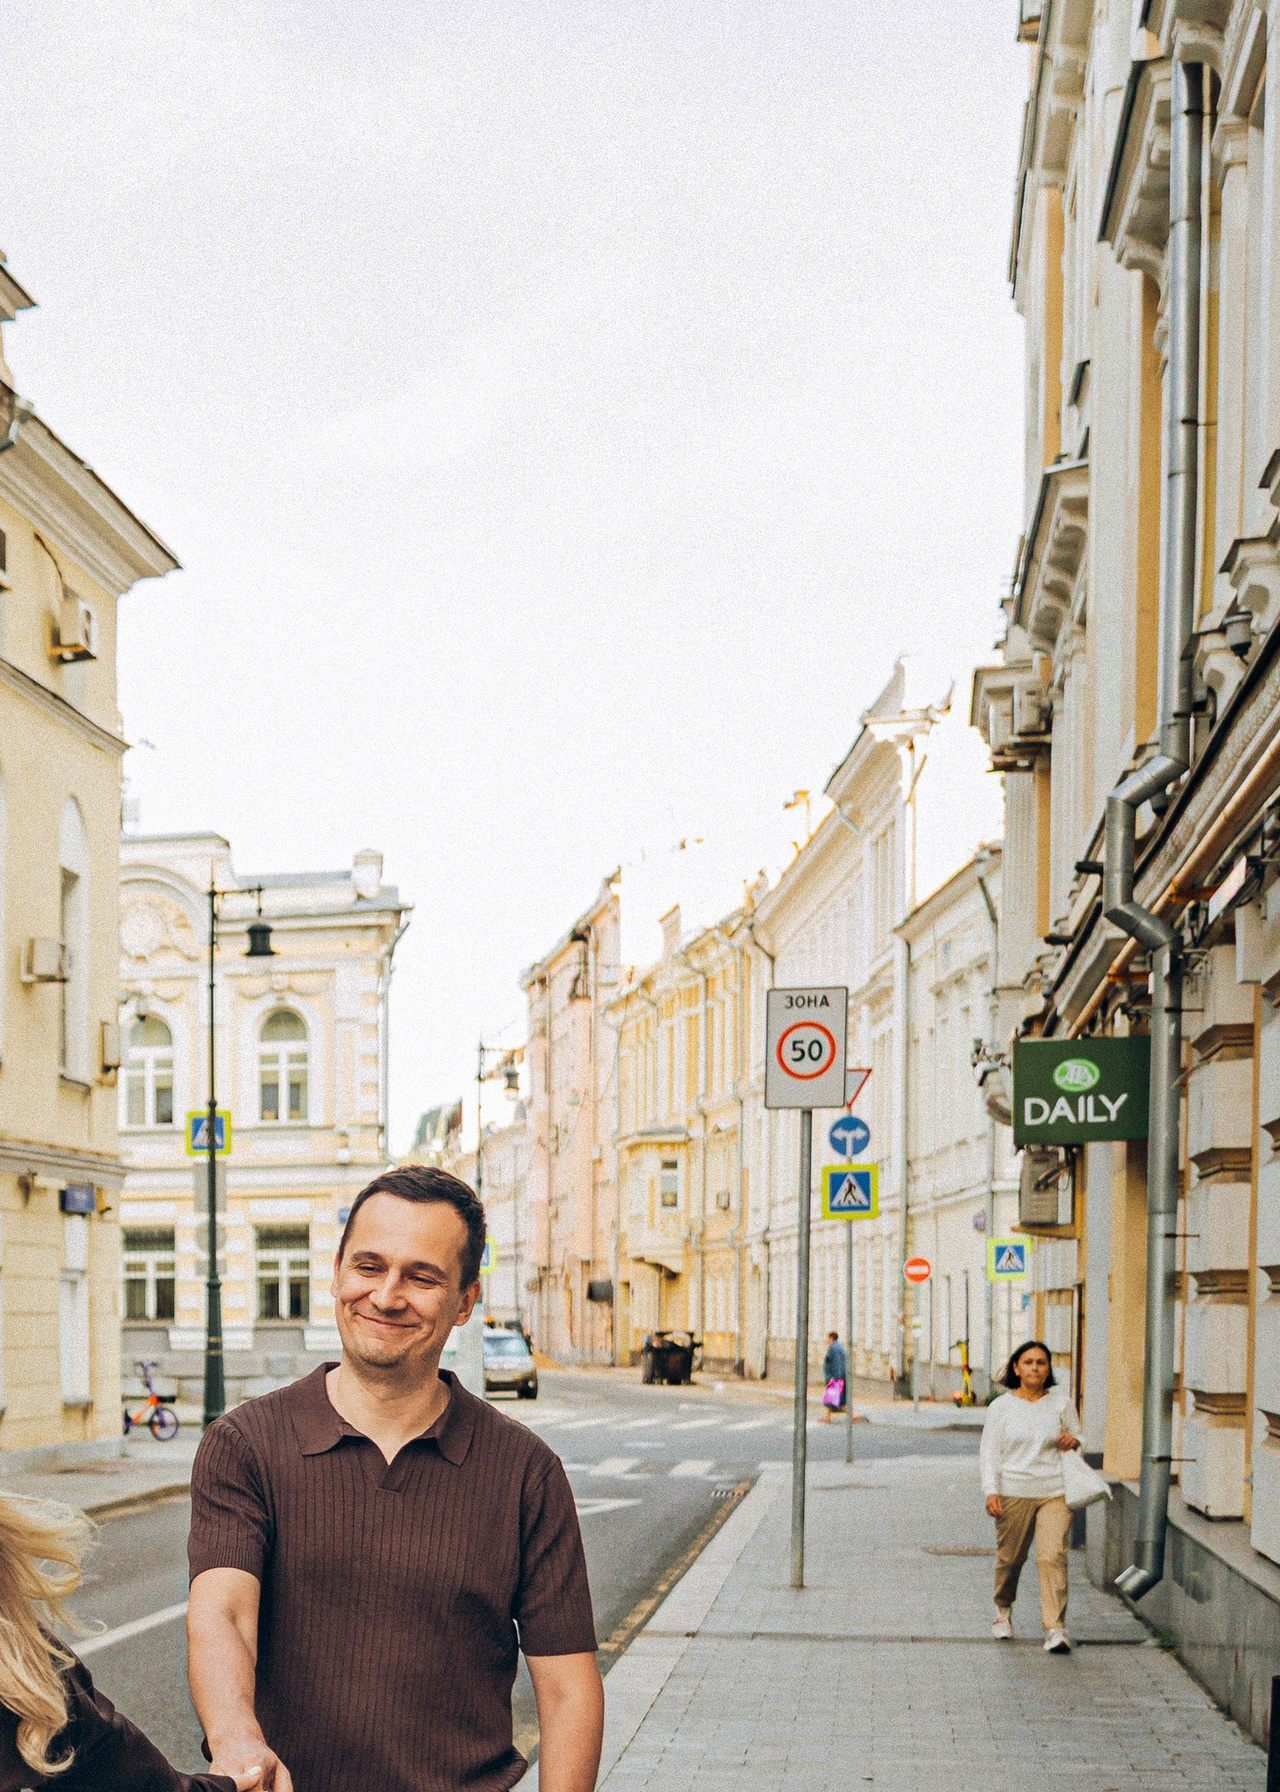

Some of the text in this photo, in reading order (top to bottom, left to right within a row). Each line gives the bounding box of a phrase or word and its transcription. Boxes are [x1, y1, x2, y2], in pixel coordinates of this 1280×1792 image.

[784, 994, 830, 1009] ЗОНА
[791, 1039, 823, 1062] 50
[1024, 1093, 1129, 1126] DAILY
